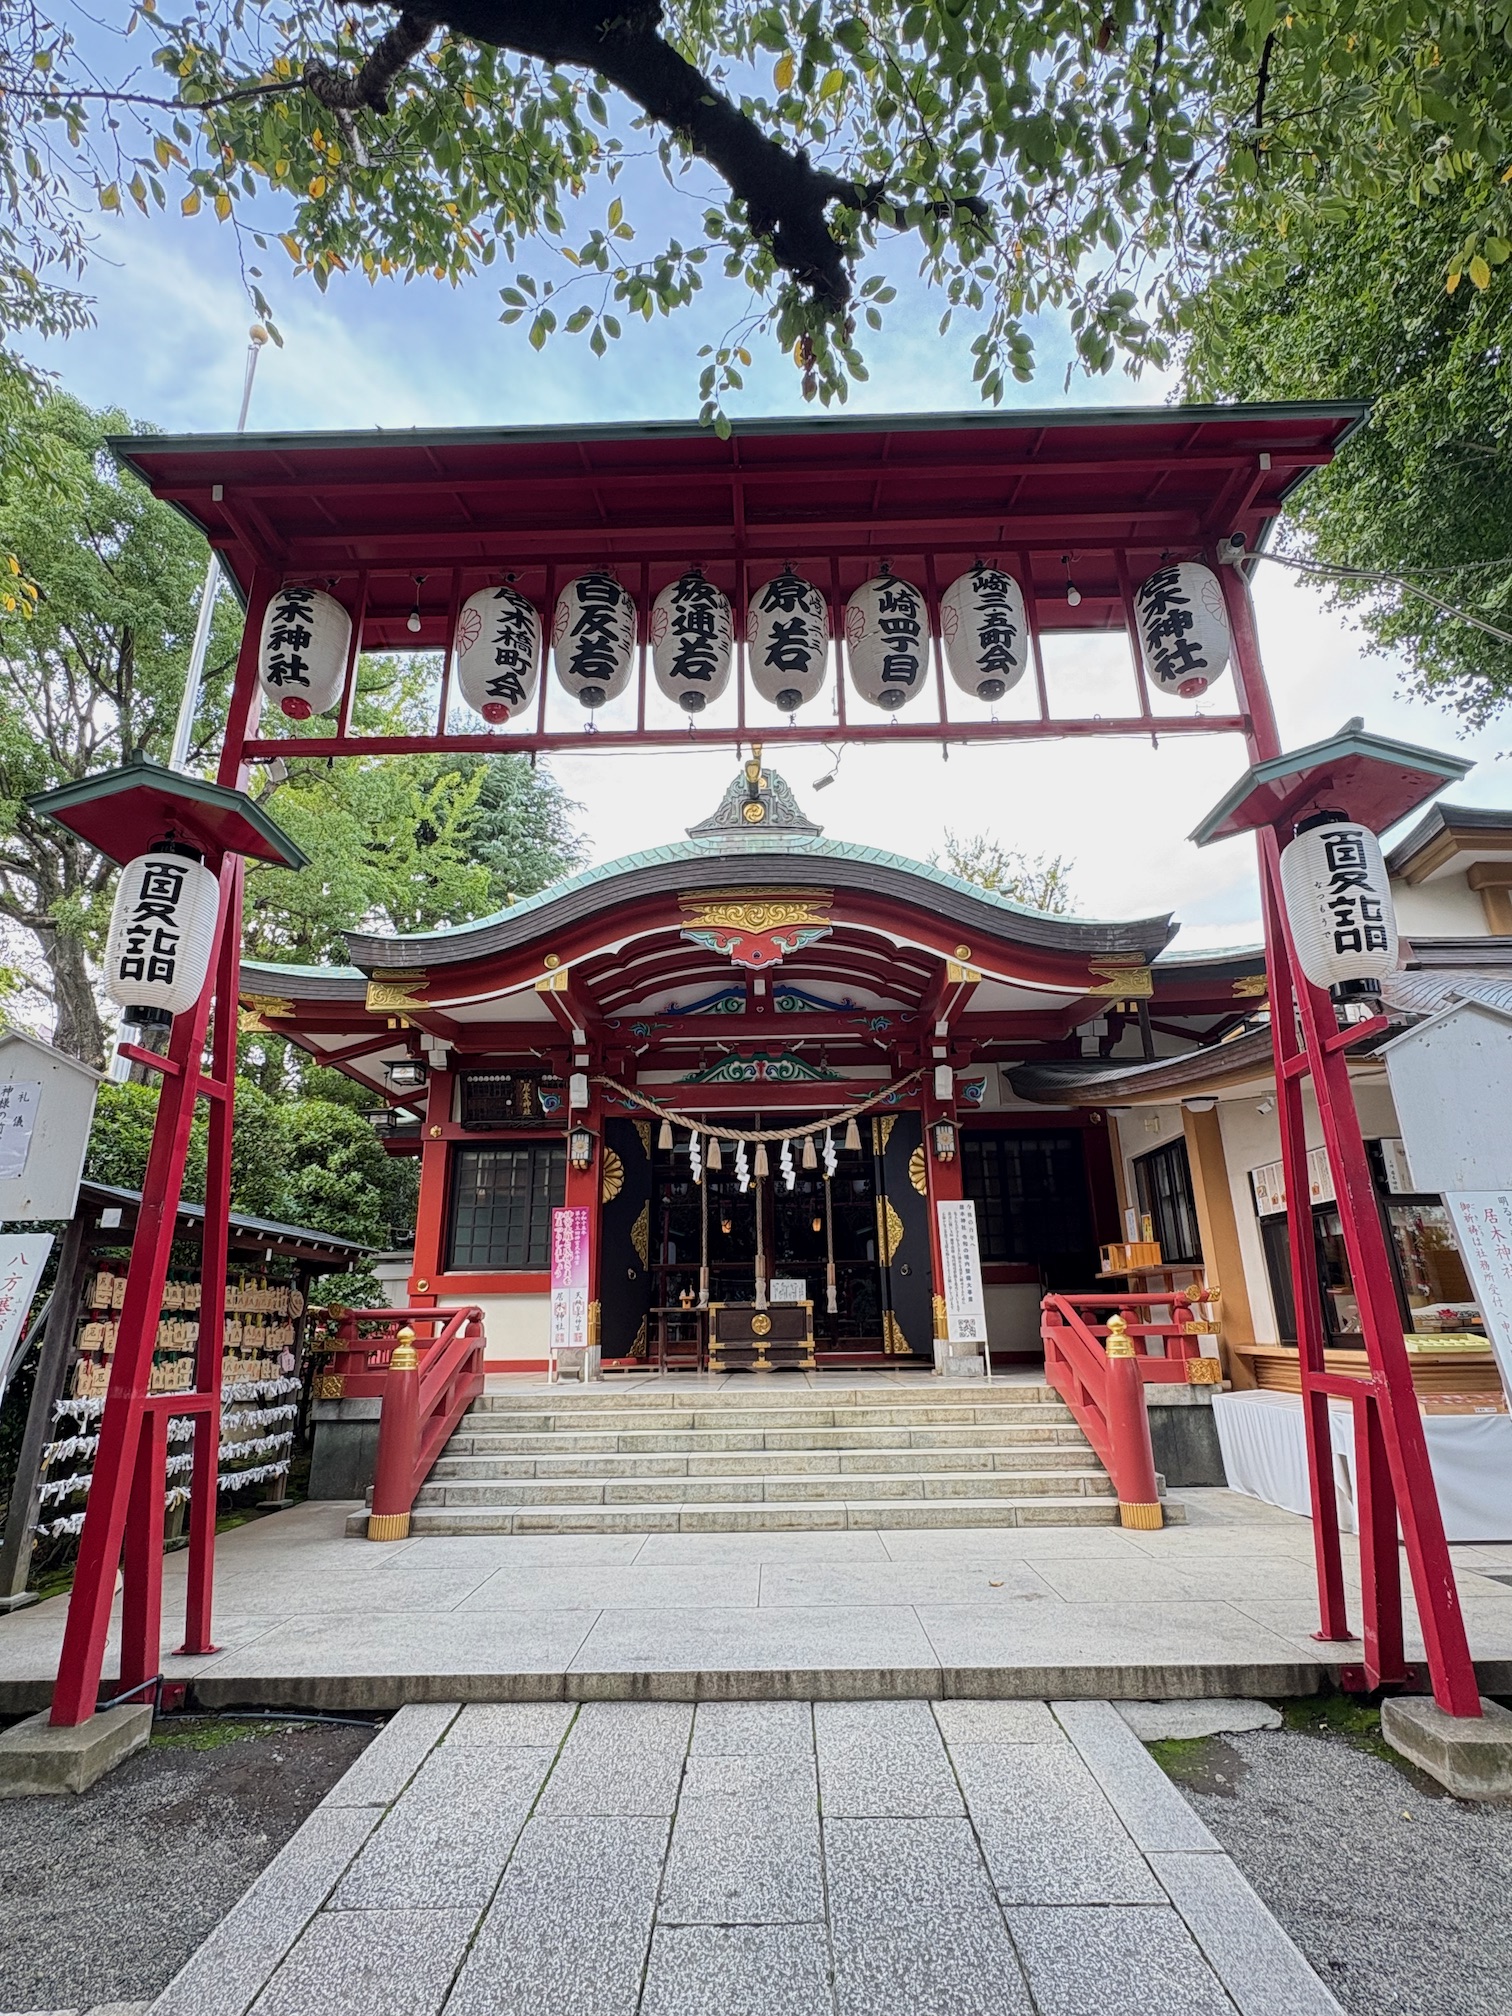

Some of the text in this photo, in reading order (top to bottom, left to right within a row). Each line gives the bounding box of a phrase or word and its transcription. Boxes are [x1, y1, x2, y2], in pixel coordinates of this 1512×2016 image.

[266, 588, 317, 688] 居木神社
[485, 587, 537, 706] 居木橋町会
[568, 575, 622, 681] 百反若
[759, 579, 812, 673] 原若
[872, 574, 921, 686] 大崎四丁目
[1137, 564, 1208, 683] 居木神社
[120, 862, 190, 985] 夏詣
[1320, 830, 1388, 954] 夏詣
